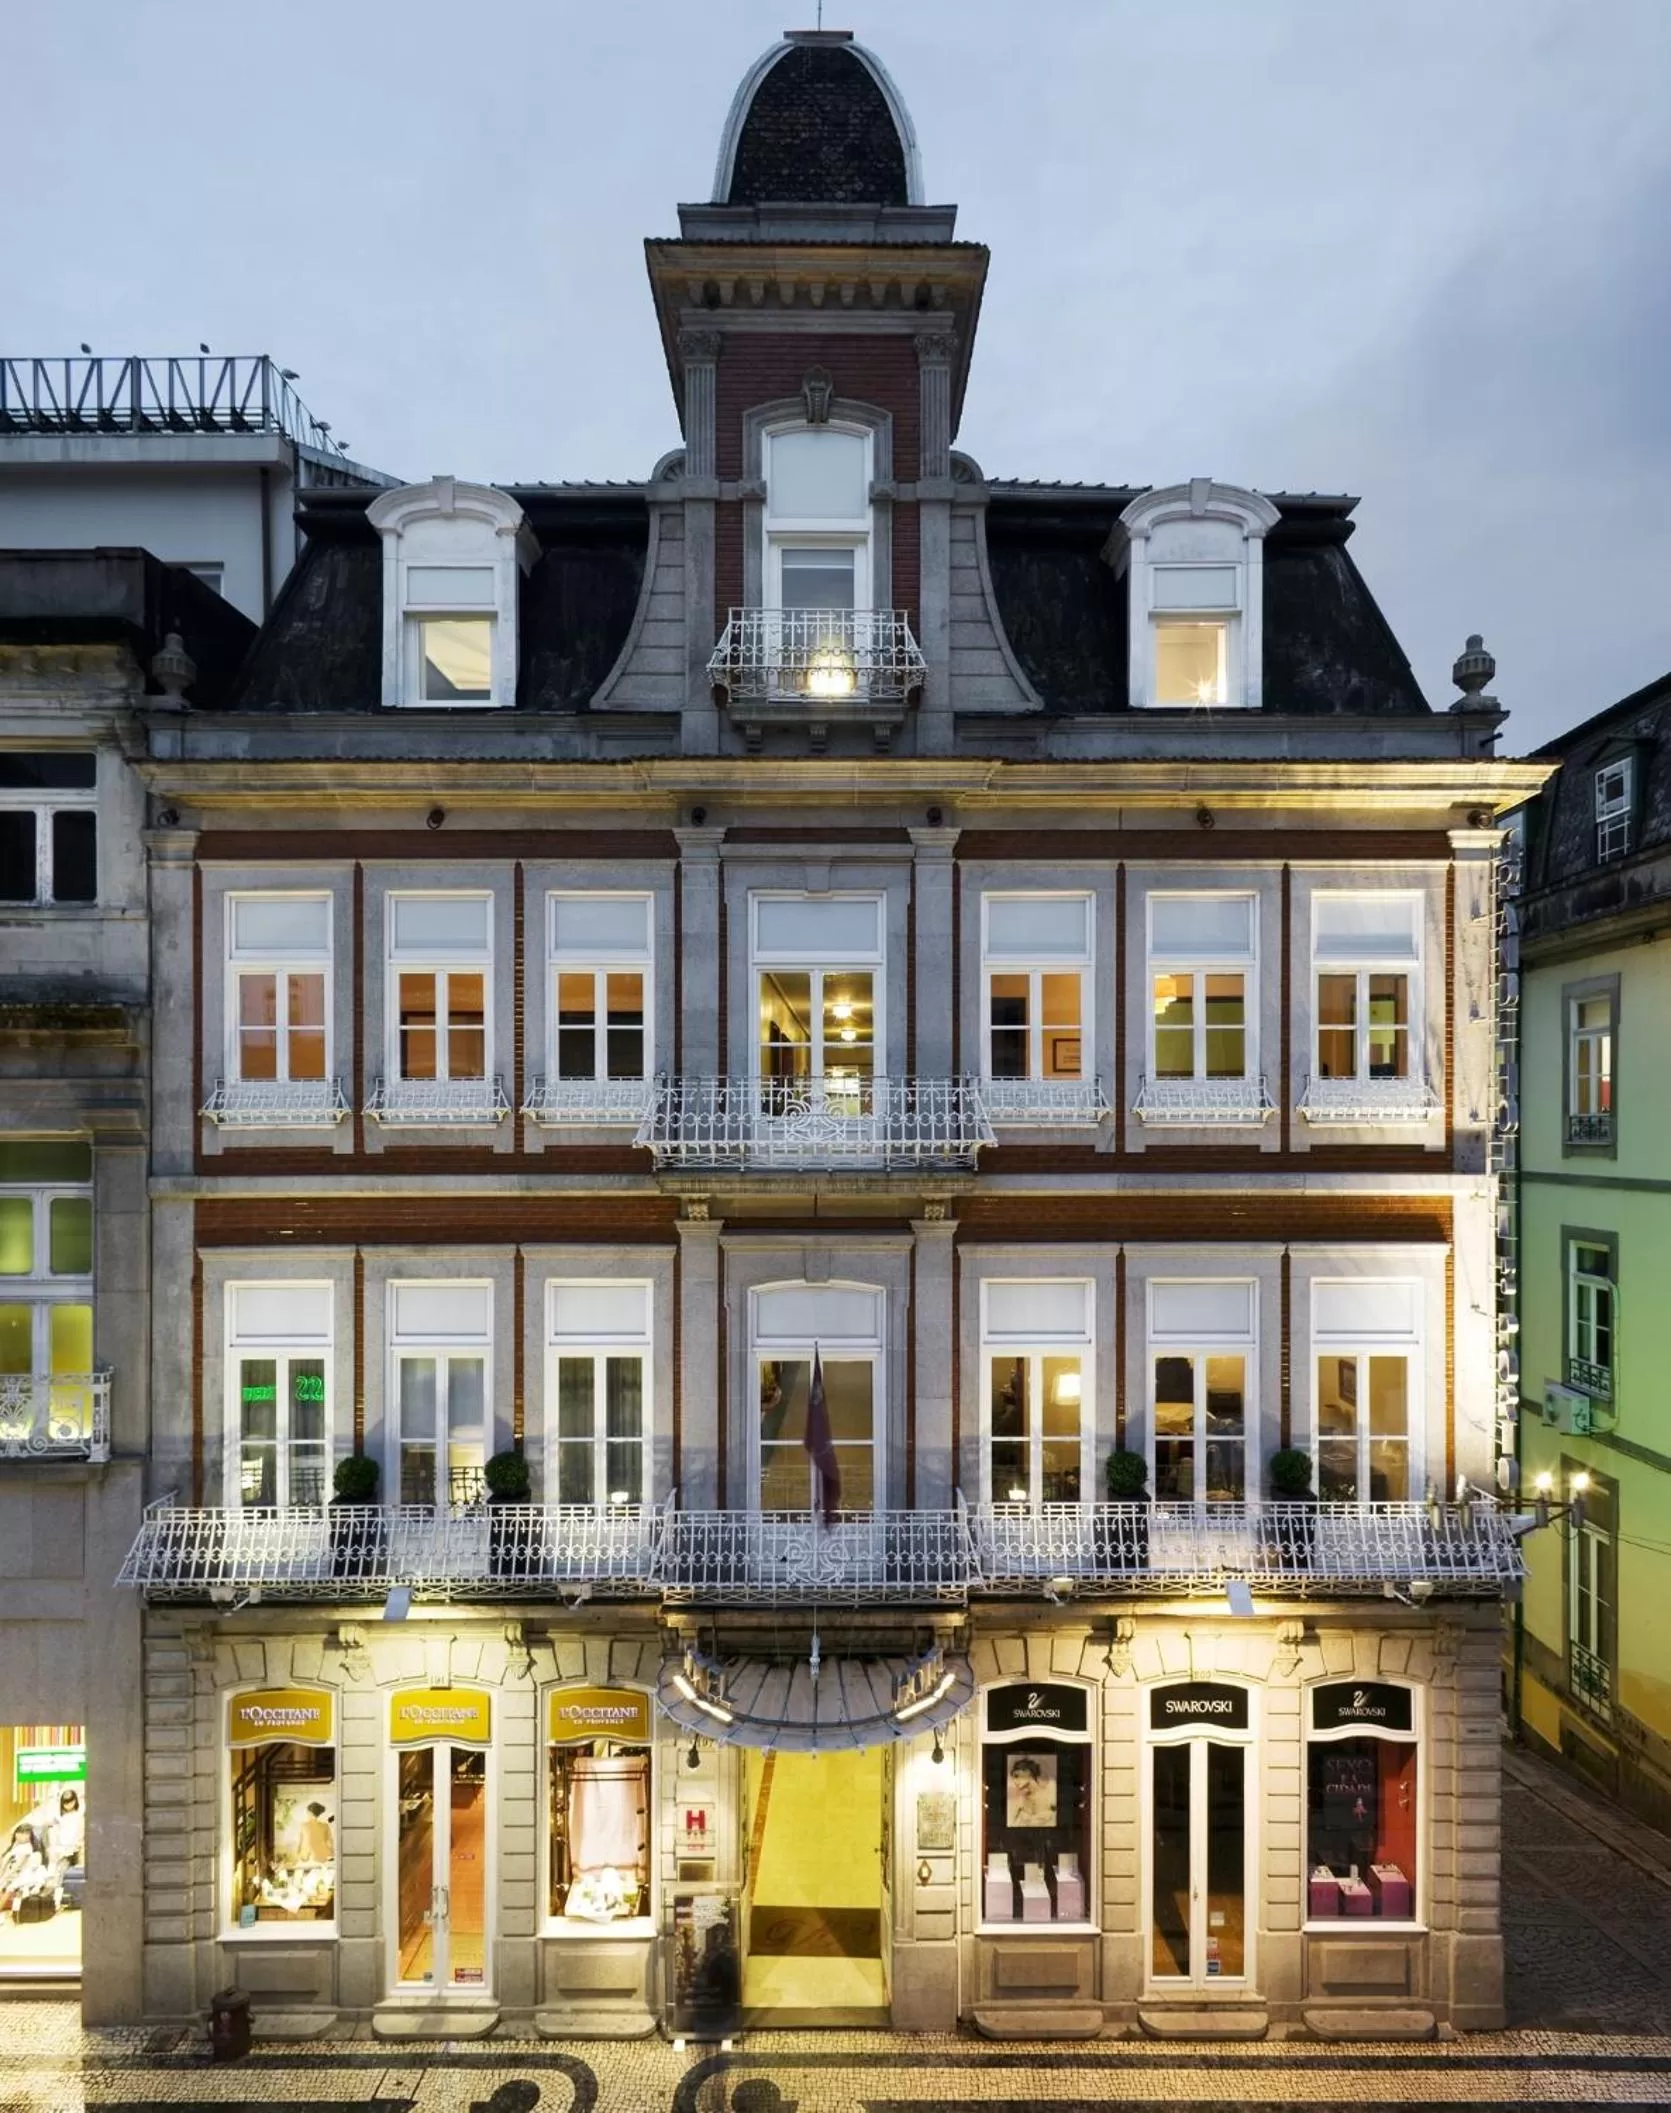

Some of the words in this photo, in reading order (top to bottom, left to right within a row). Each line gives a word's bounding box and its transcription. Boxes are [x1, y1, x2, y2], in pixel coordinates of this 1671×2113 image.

[240, 1706, 321, 1720] L'OCCITANE
[560, 1705, 639, 1719] L'OCCITANE
[1165, 1700, 1233, 1713] SWAROVSKI
[1338, 1707, 1386, 1717] SWAROVSKI
[1013, 1709, 1061, 1718] SWAROVSKI
[686, 1809, 705, 1831] H
